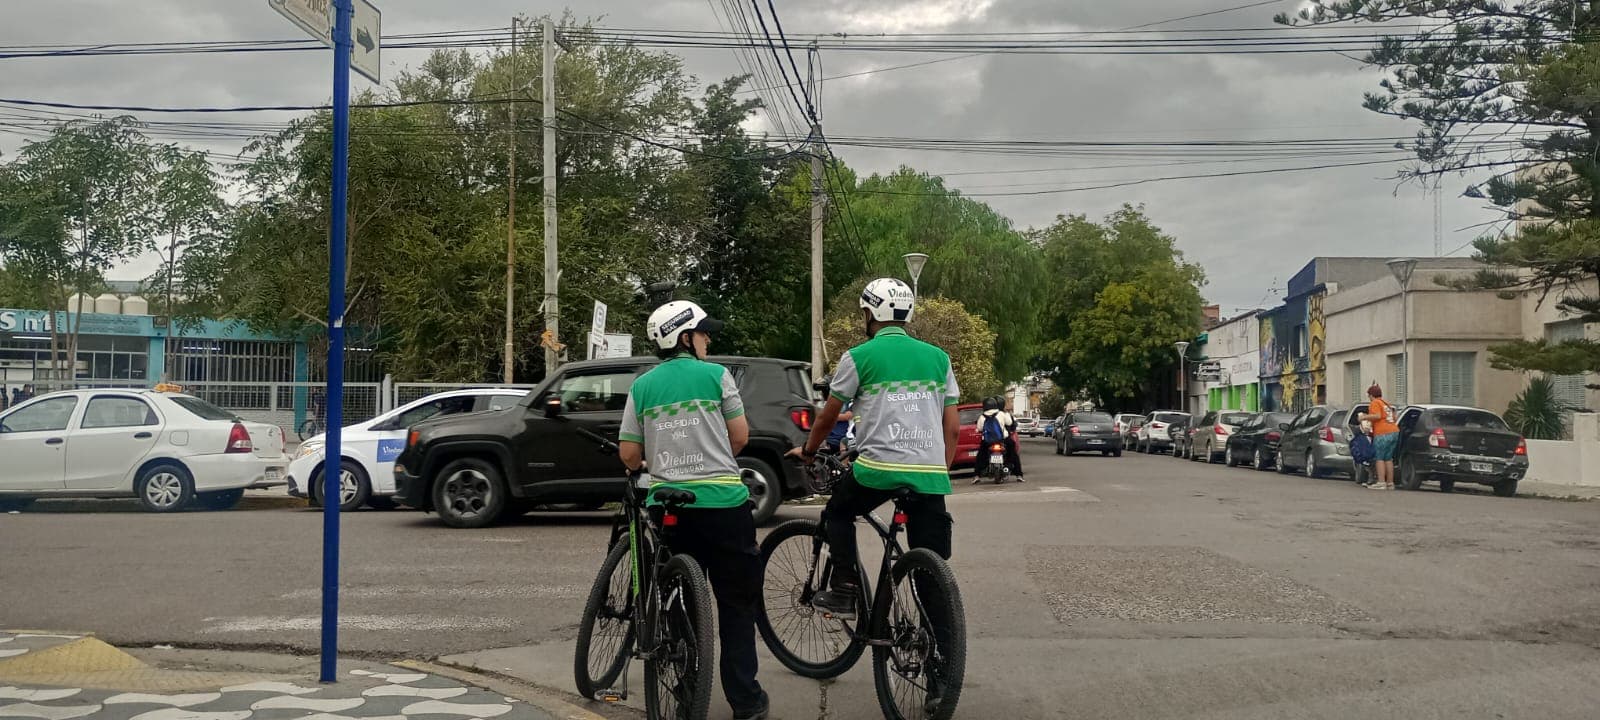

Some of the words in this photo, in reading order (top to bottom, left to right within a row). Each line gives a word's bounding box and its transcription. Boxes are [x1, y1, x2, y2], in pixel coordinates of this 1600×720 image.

[887, 391, 932, 402] SEGURIDAD
[904, 402, 920, 412] VIAL
[656, 417, 700, 431] SEGURIDAD
[888, 422, 933, 440] Viedma
[894, 440, 933, 449] COMUNIDAD
[657, 449, 704, 468] Viedma
[665, 463, 704, 477] COMUNIDAD
